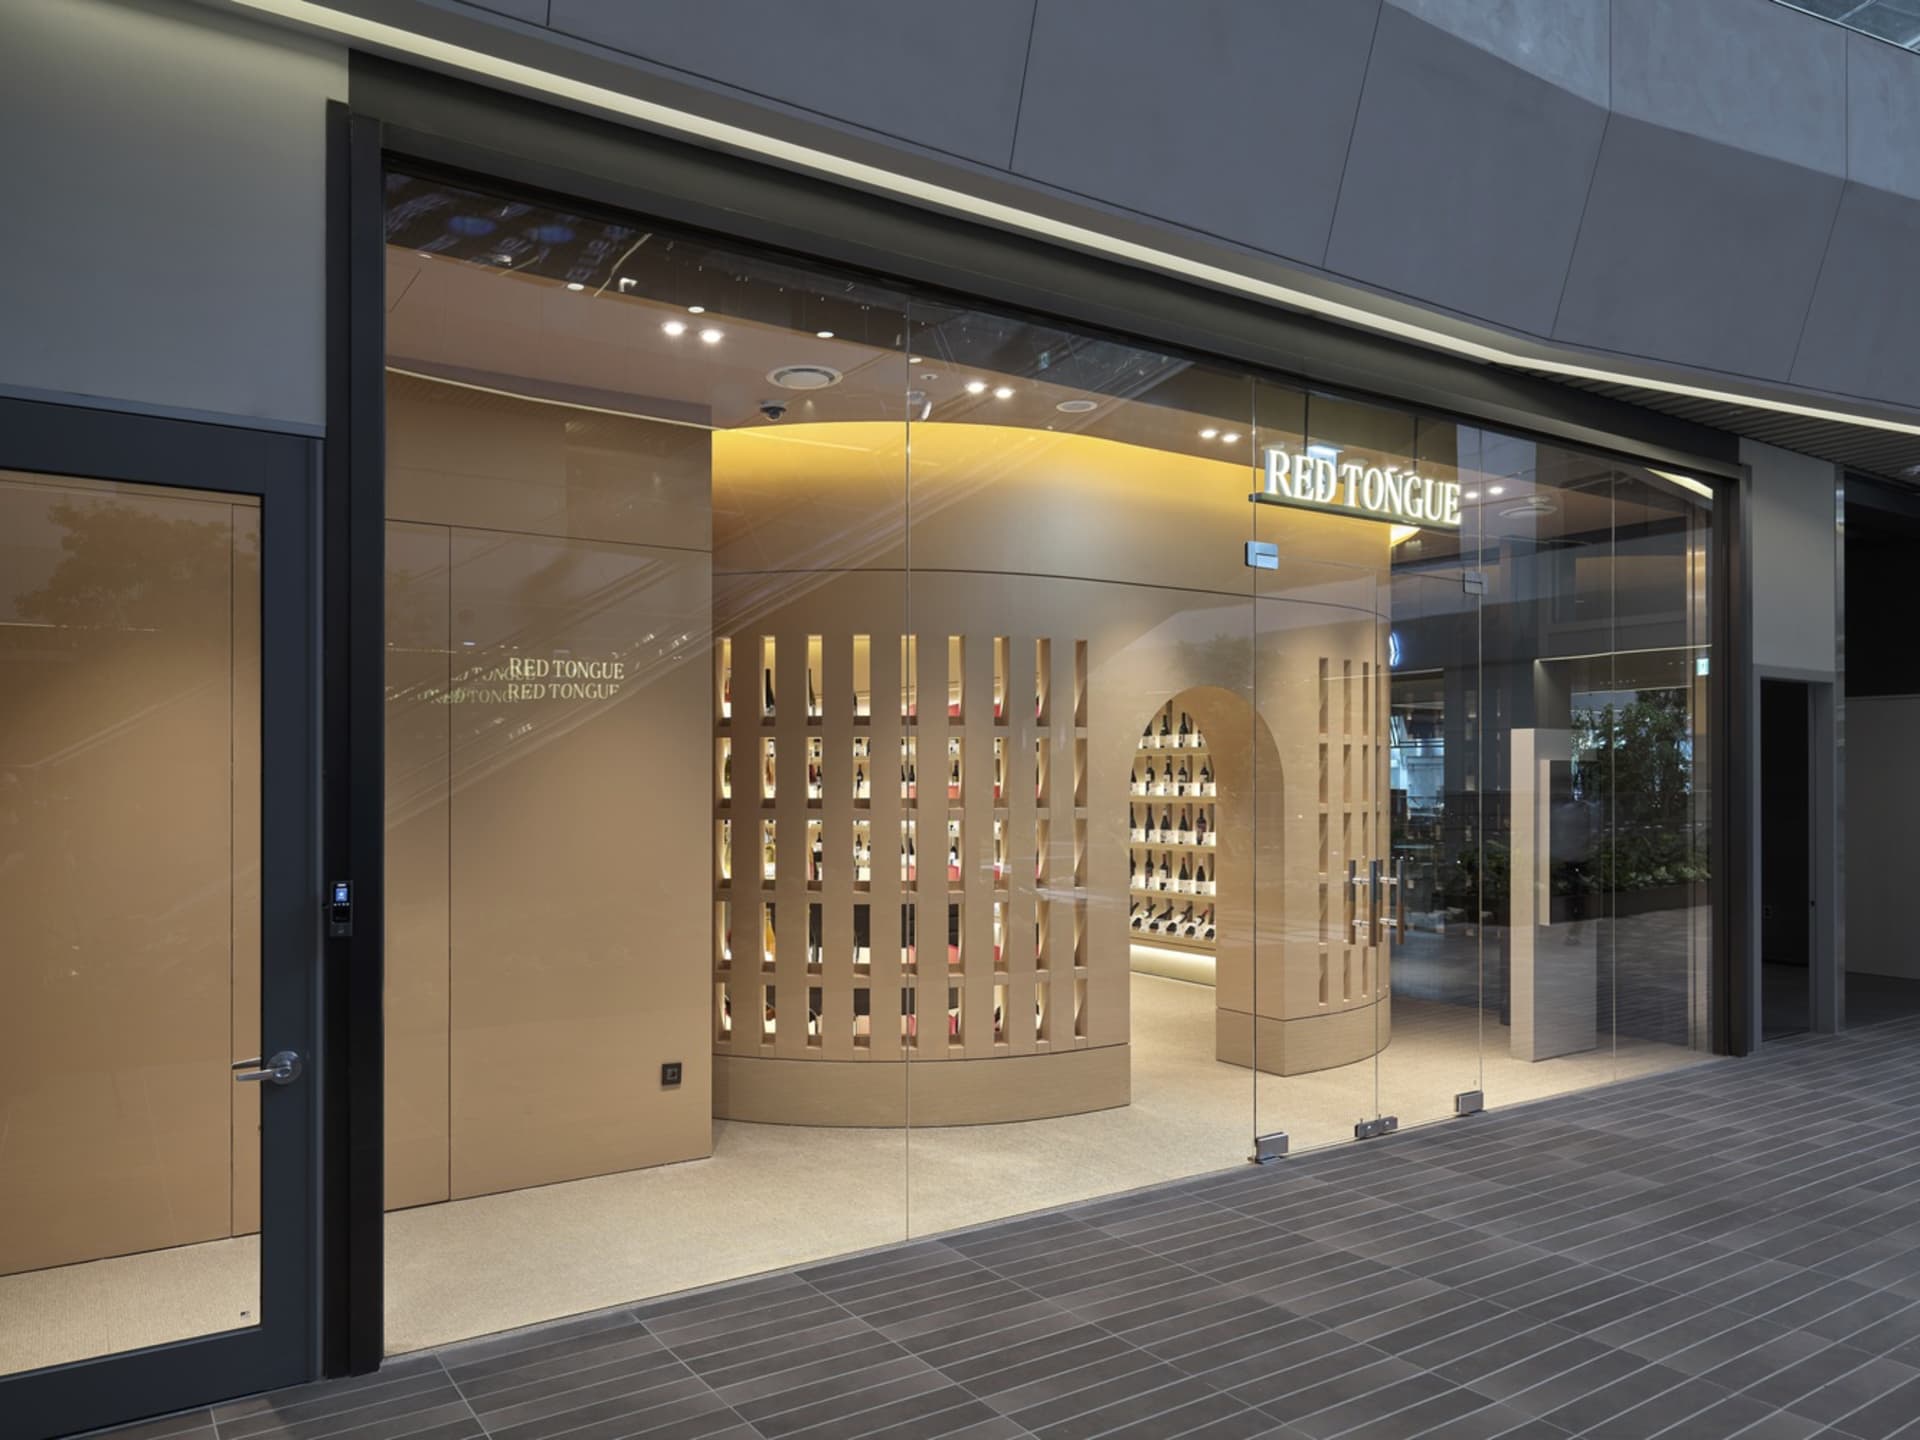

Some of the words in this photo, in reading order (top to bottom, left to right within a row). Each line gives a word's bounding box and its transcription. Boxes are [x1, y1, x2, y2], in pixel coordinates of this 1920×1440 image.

[1267, 449, 1338, 504] RED
[1343, 463, 1462, 525] TONGUE
[509, 657, 549, 678] RED
[552, 660, 625, 680] TONGUE
[507, 683, 546, 700] RED
